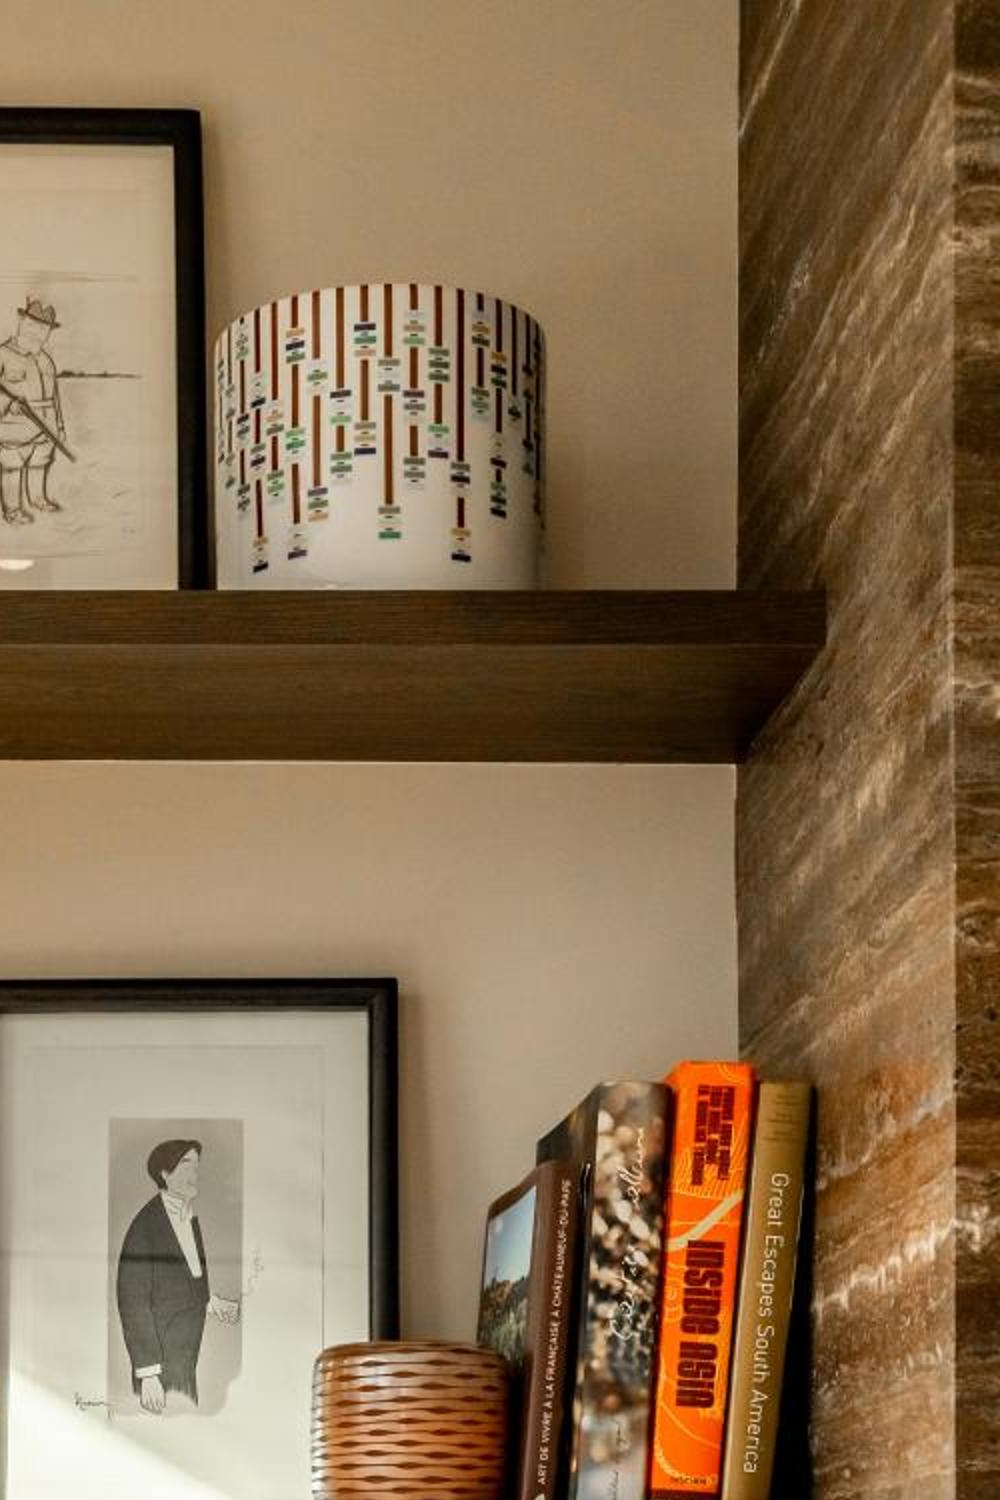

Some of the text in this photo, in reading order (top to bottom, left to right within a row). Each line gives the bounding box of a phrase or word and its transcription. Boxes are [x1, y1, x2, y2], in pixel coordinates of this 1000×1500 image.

[744, 1172, 788, 1474] Great Escapes South America
[543, 1383, 555, 1399] LA
[540, 1414, 552, 1443] VIVRE
[538, 1446, 549, 1461] DE
[537, 1464, 548, 1485] ART
